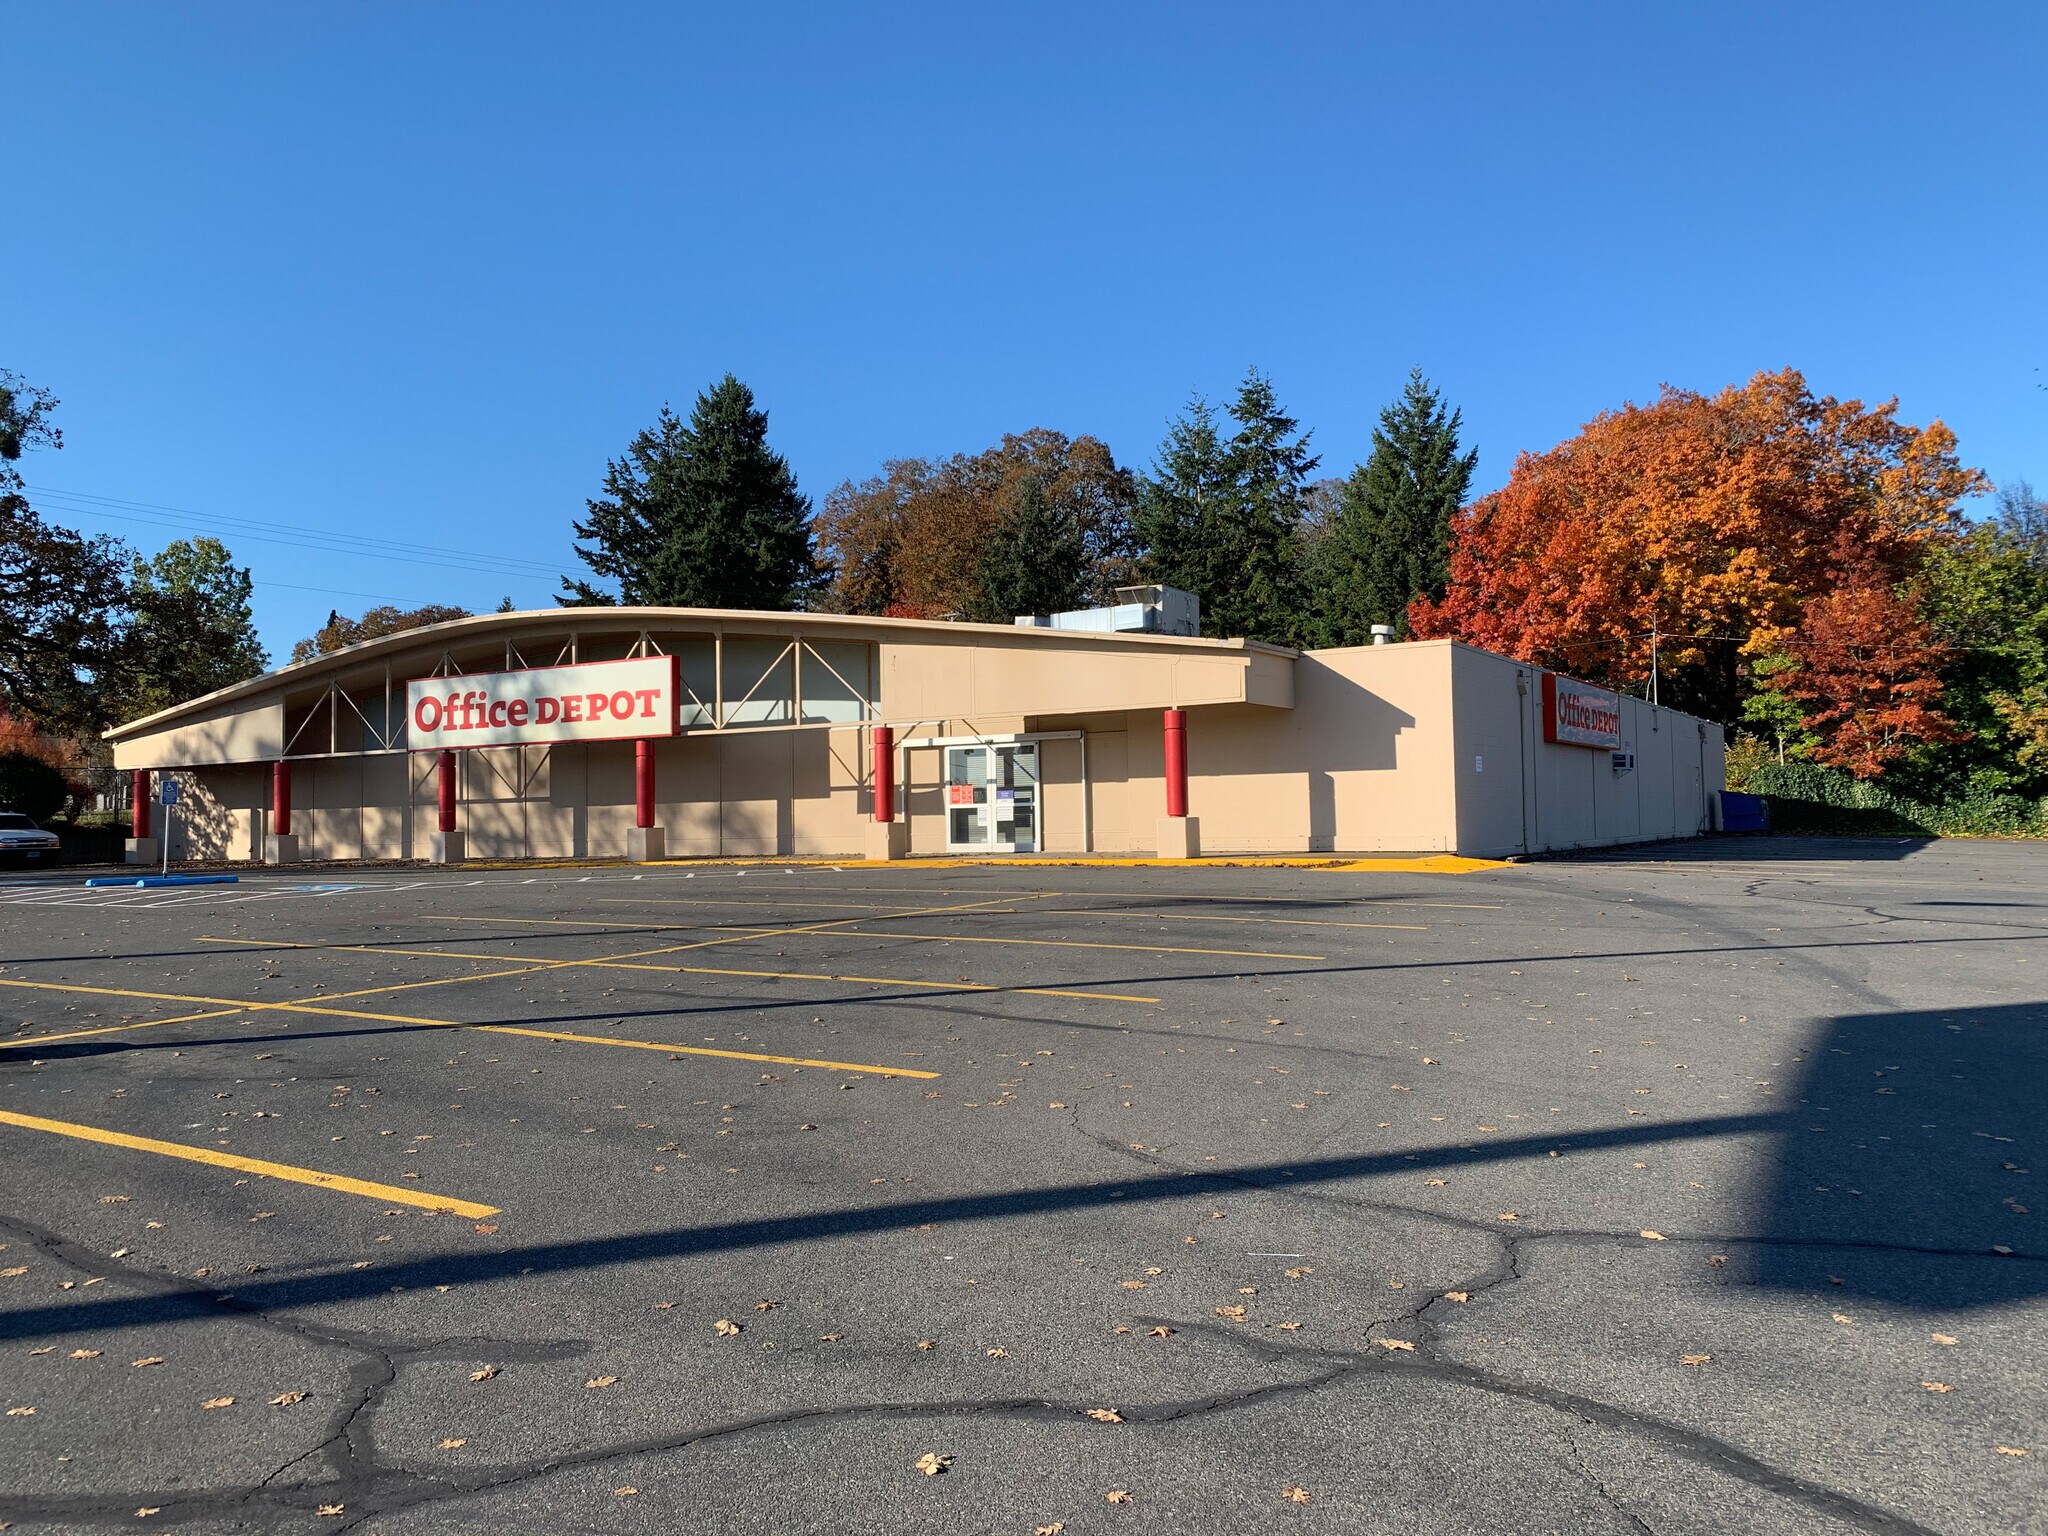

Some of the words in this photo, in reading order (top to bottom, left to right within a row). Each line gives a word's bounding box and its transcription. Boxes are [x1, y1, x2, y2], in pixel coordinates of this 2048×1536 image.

[415, 691, 528, 733] Office
[535, 689, 661, 725] DEPOT
[1558, 692, 1590, 729] Office
[1592, 710, 1618, 734] DEPOT
